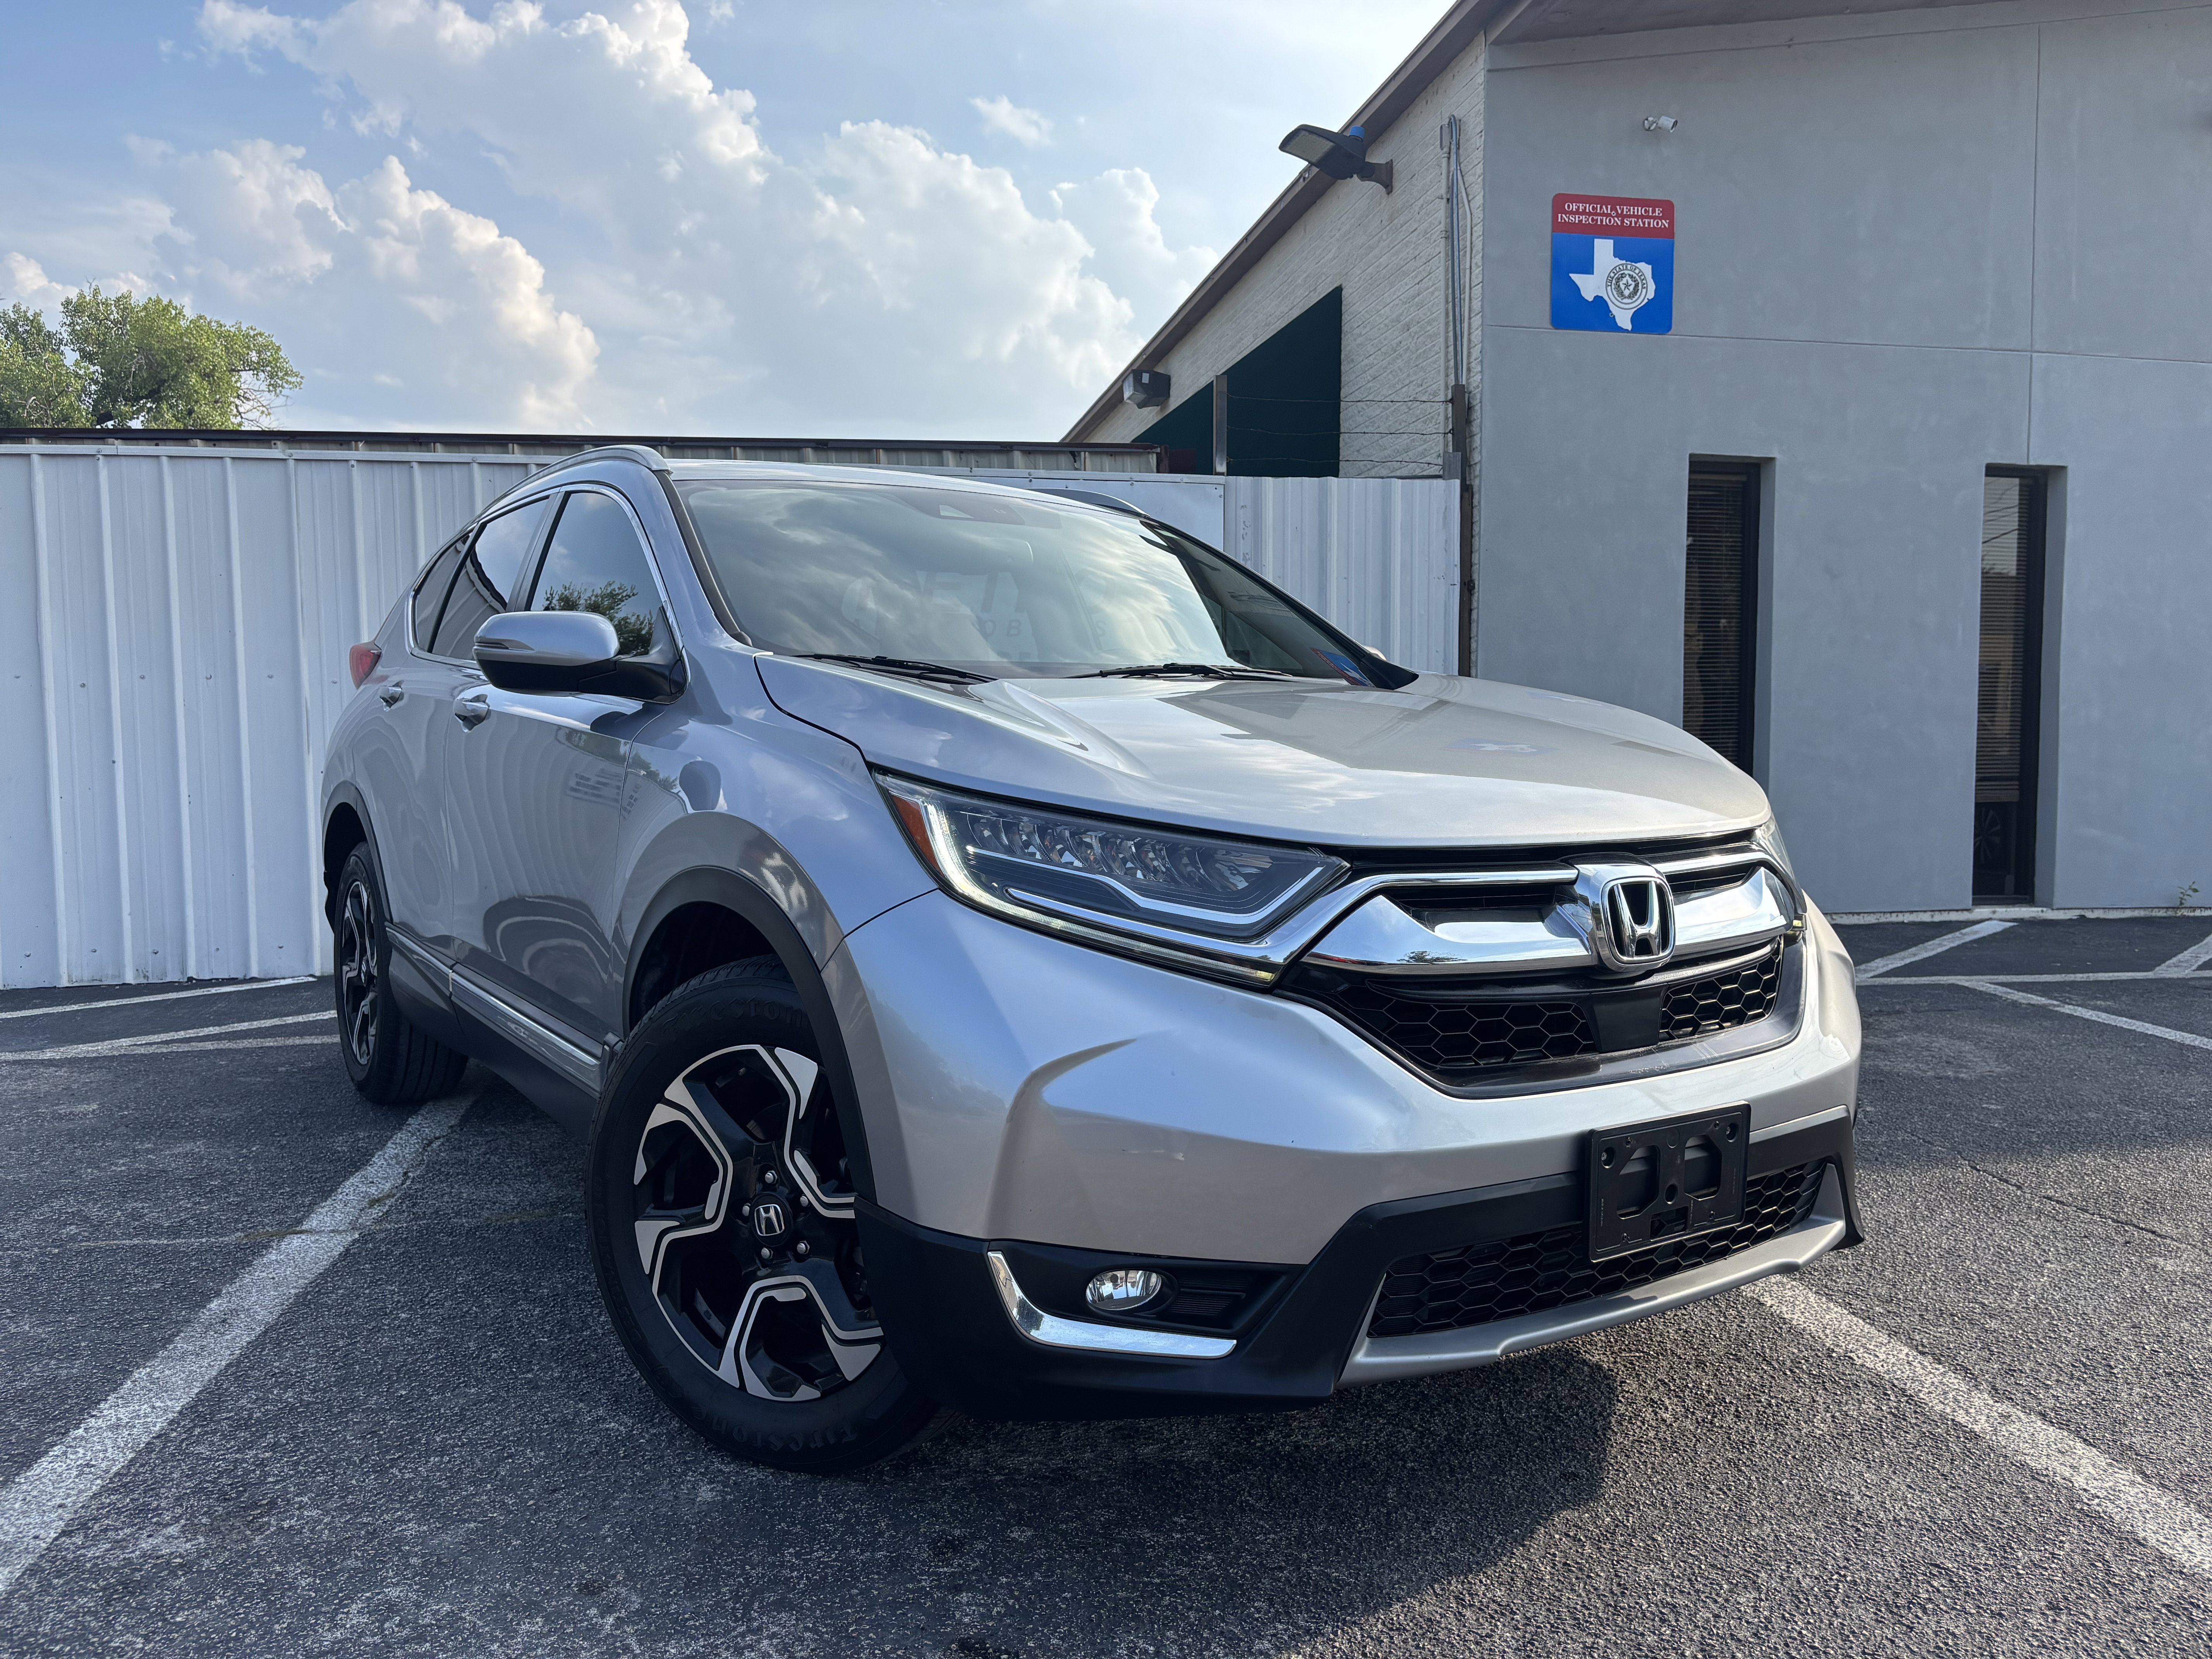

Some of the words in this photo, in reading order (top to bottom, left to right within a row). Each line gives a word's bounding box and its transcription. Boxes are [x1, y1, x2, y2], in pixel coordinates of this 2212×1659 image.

[1558, 214, 1621, 226] INSPECTION
[1624, 218, 1669, 228] STATION
[1565, 203, 1612, 213] OFFICIAL
[1616, 206, 1662, 216] VEHICLE
[1612, 265, 1628, 275] STATE
[1637, 271, 1646, 290] TEXAS
[662, 995, 809, 1033] Fireston
[691, 1402, 858, 1452] Firestone
